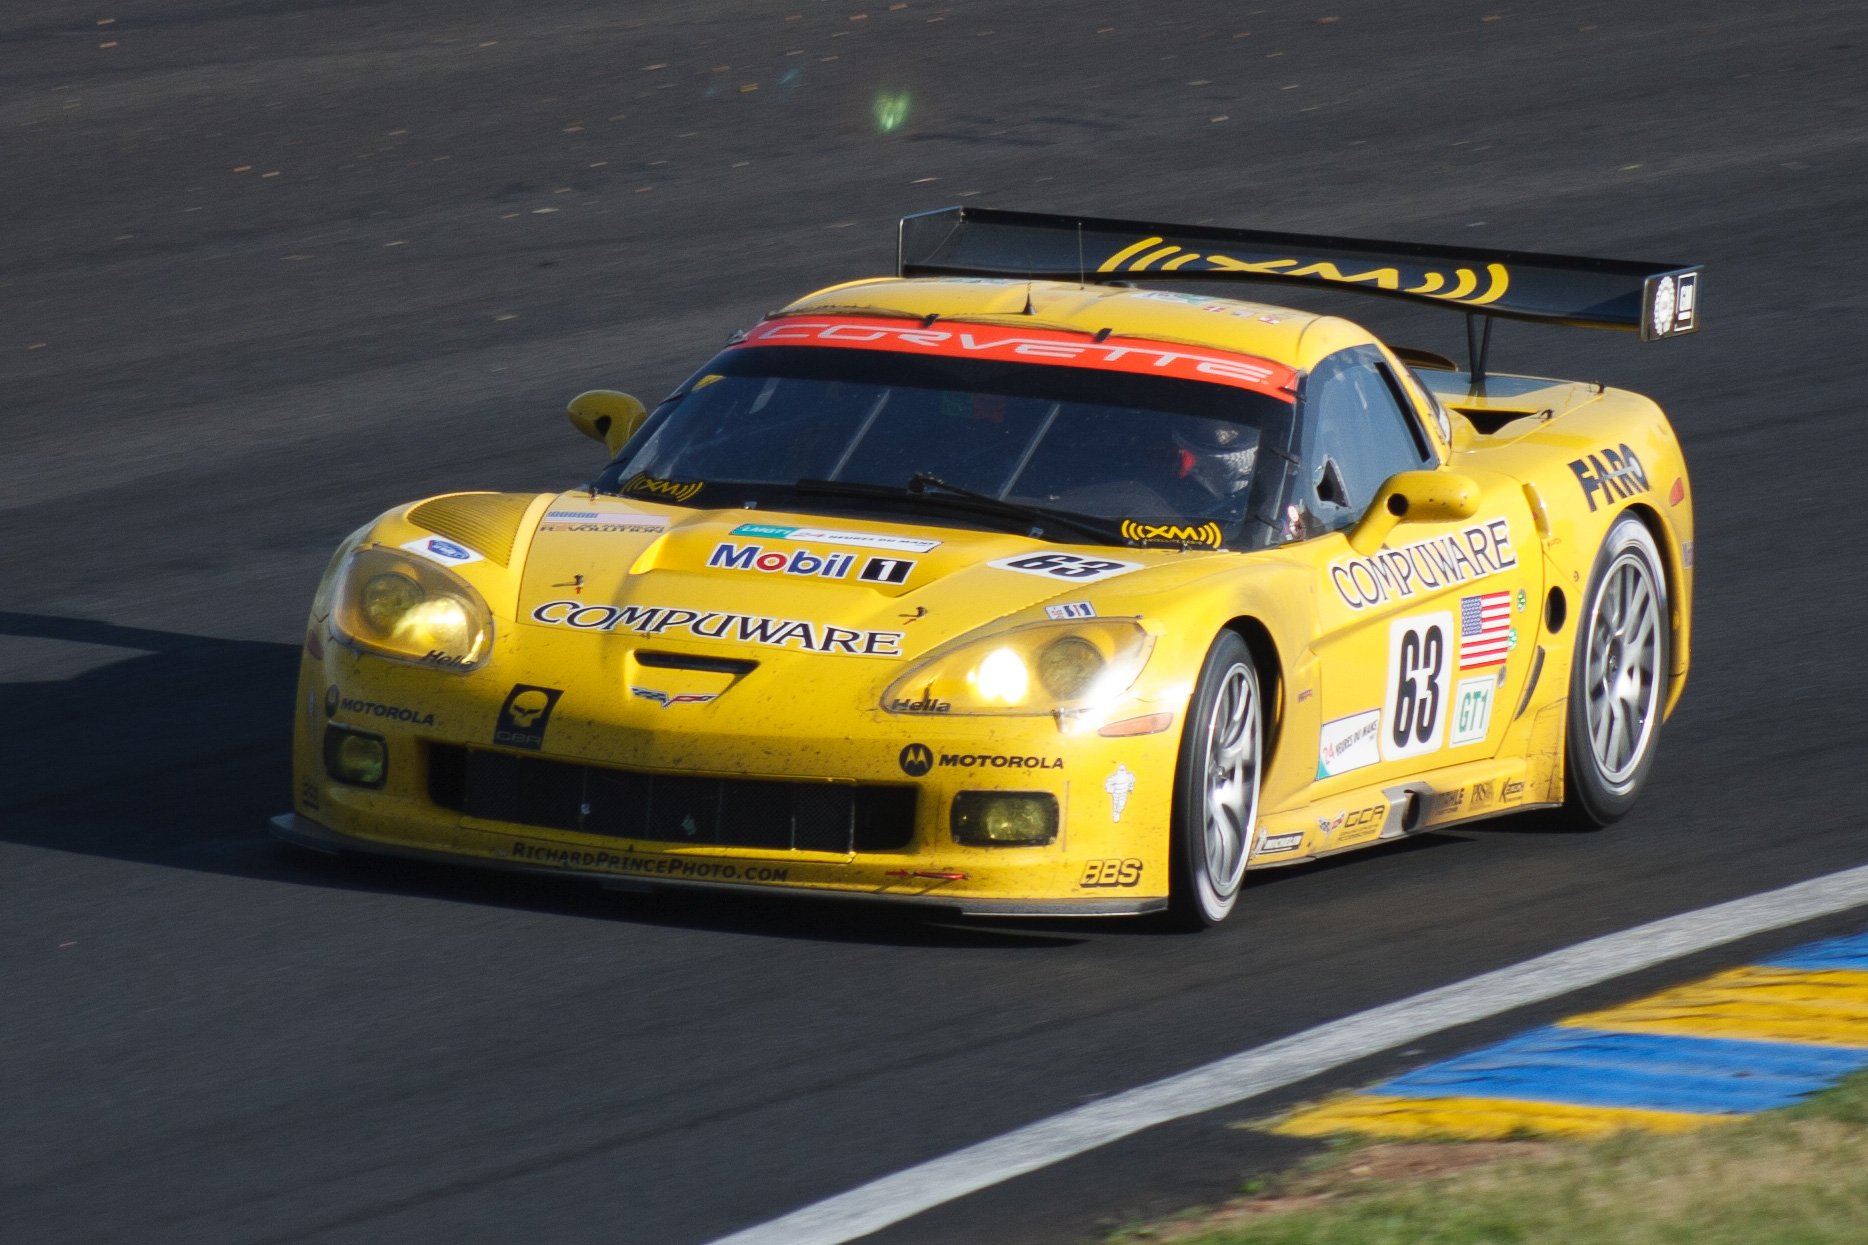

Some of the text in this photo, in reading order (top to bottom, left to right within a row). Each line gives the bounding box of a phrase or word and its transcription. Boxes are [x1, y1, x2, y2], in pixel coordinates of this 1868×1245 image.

[758, 323, 1275, 383] CORVETTE
[1567, 443, 1650, 513] FARO
[791, 531, 825, 539] 24
[828, 534, 875, 542] HEURES
[898, 539, 935, 547] MANS
[709, 543, 856, 579] Mobil
[1006, 554, 1126, 578] 63
[1331, 520, 1517, 609] COMPUWARE
[532, 601, 903, 655] COMPUWARE
[1392, 624, 1444, 749] 63
[340, 698, 436, 727] MOTOROLA
[891, 698, 951, 713] Hella
[1458, 689, 1489, 733] GT1
[938, 754, 1064, 770] MOTOROLA
[1322, 742, 1336, 765] 24
[1080, 858, 1144, 888] BBS
